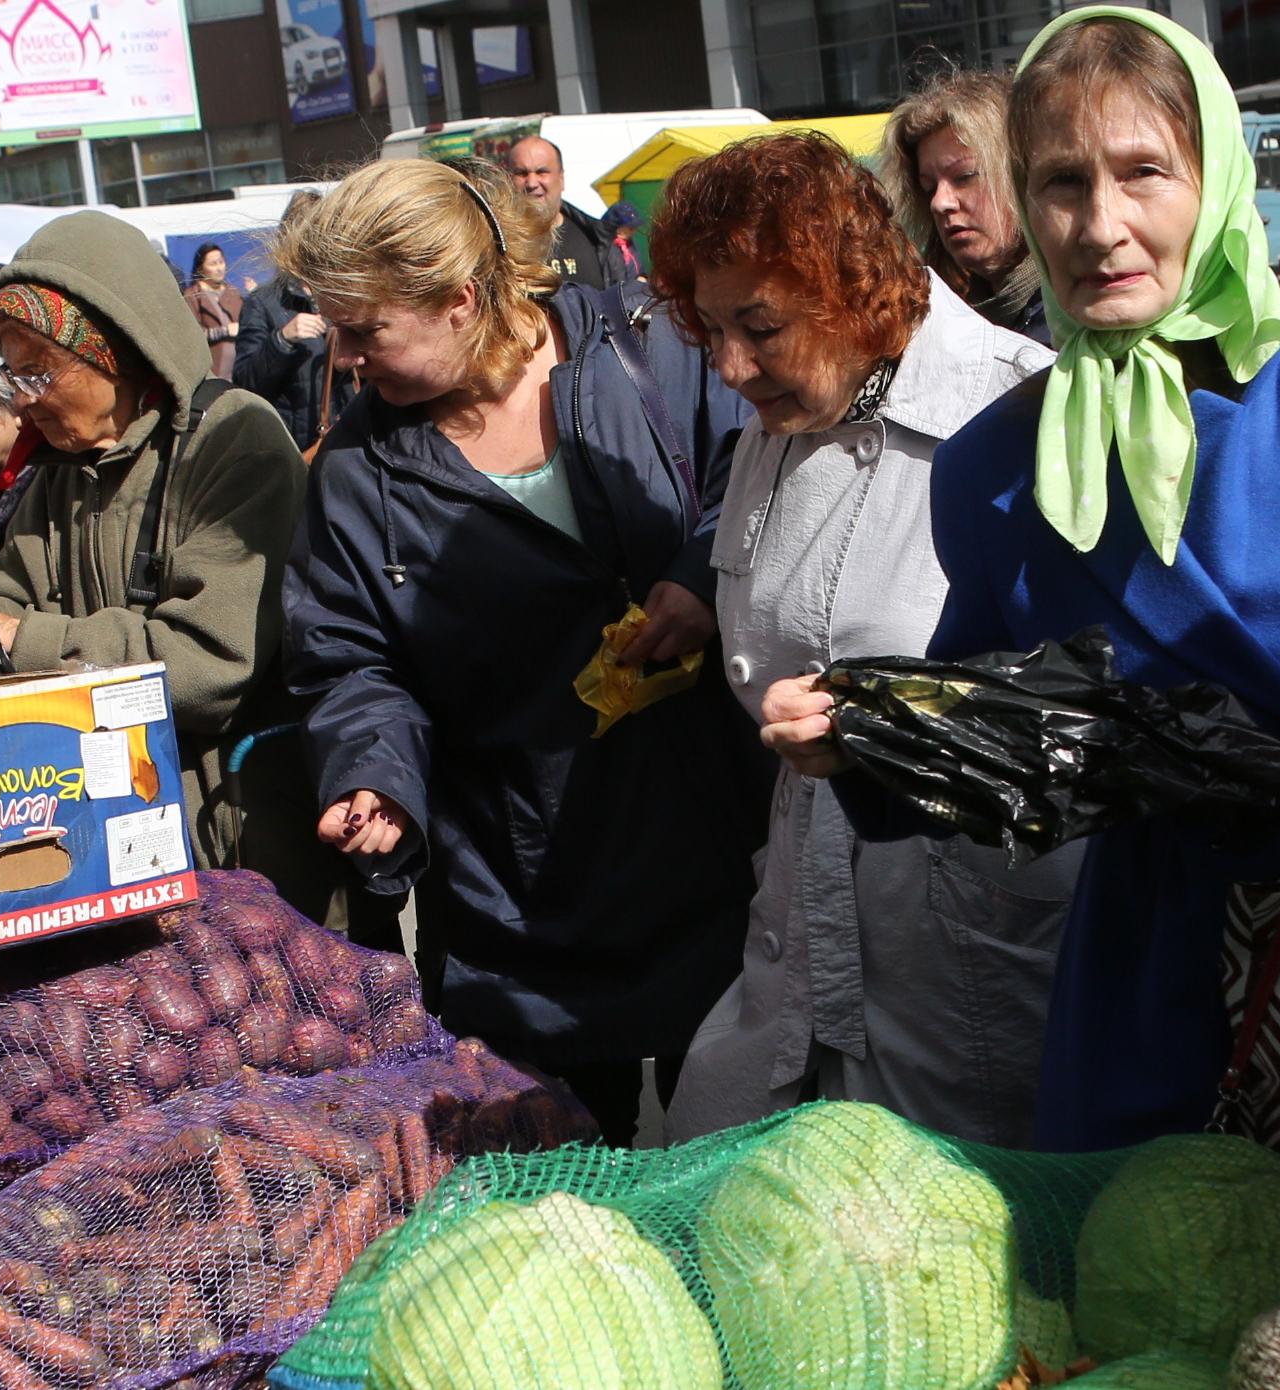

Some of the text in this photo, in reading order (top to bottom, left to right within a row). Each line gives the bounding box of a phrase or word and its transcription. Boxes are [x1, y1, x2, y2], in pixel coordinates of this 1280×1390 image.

[20, 33, 72, 50] МИСС
[22, 51, 76, 65] РОССИЯ
[112, 880, 185, 913] EXTRA
